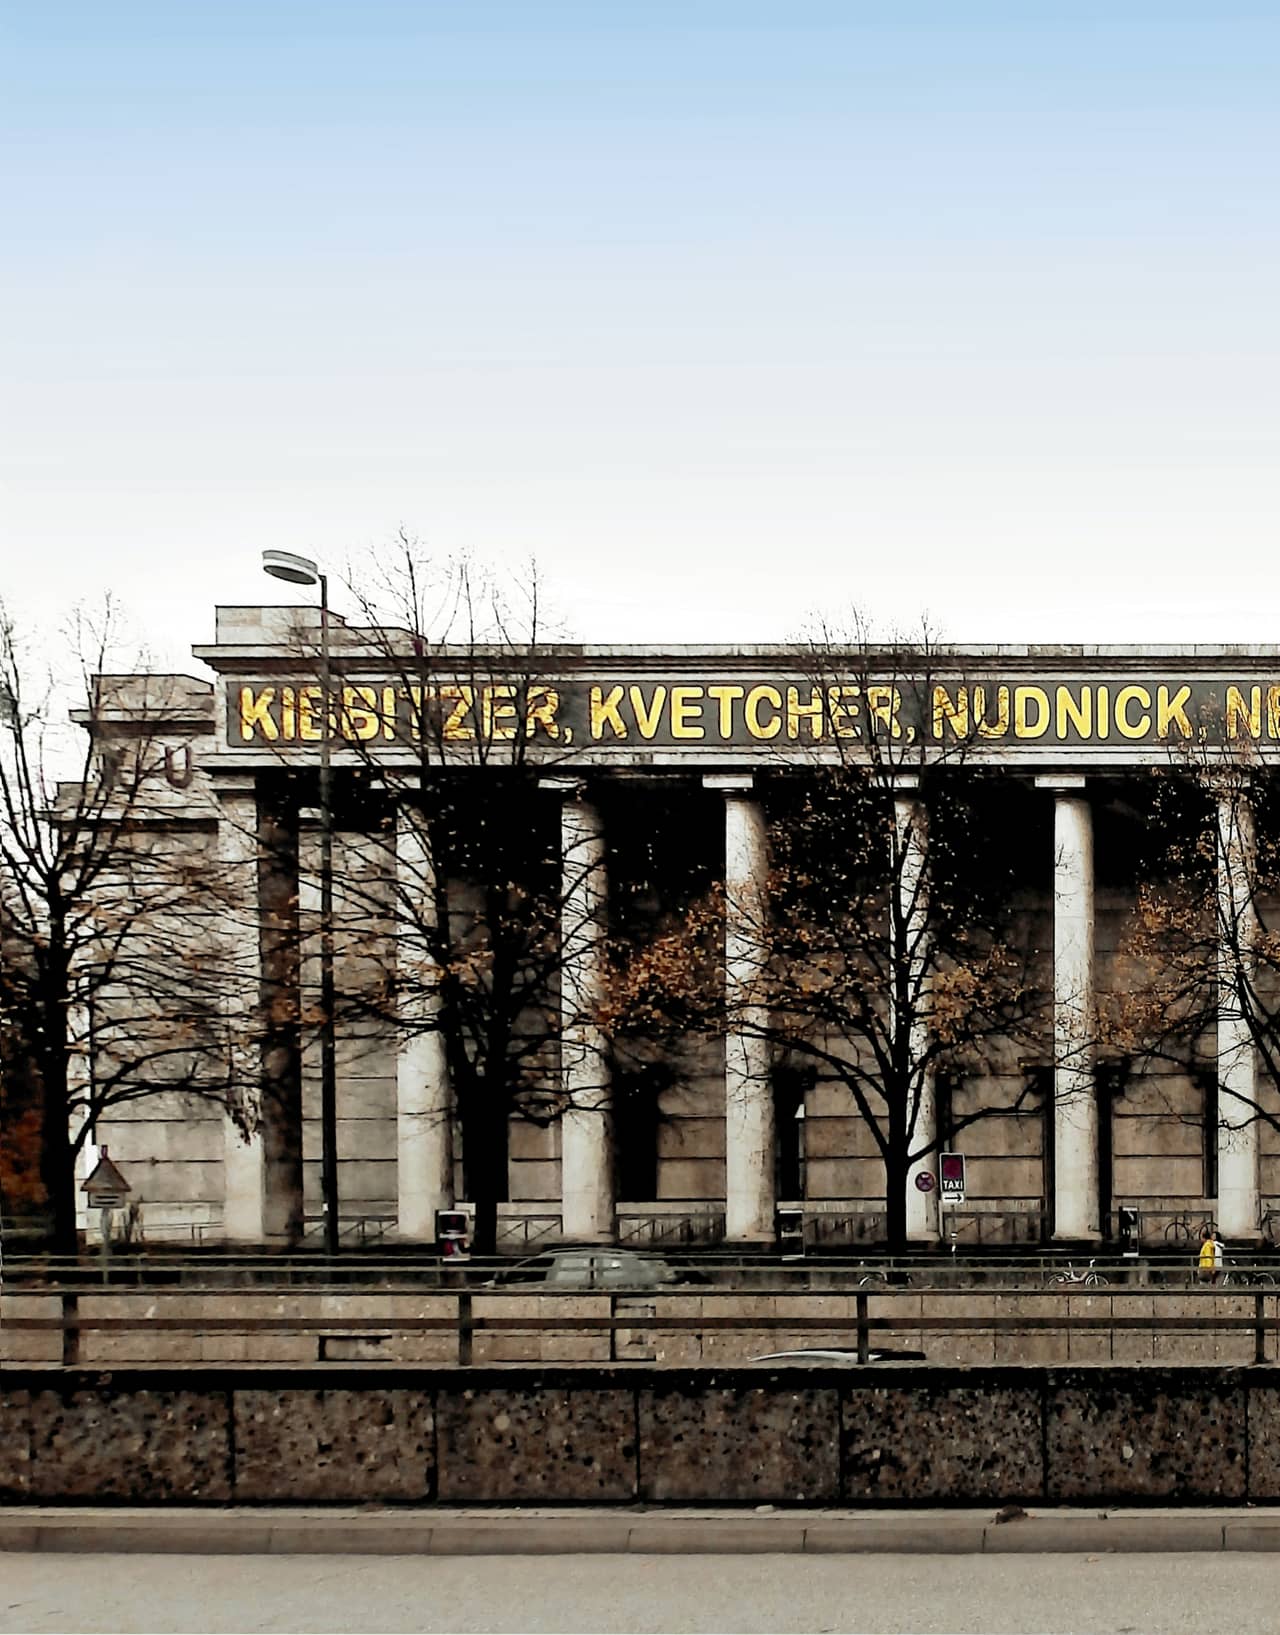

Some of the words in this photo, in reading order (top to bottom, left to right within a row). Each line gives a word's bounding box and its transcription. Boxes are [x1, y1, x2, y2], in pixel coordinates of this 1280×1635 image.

[588, 683, 916, 744] KVETCHER,
[931, 683, 1208, 744] NUDNICK,
[943, 1180, 963, 1190] TAXI
